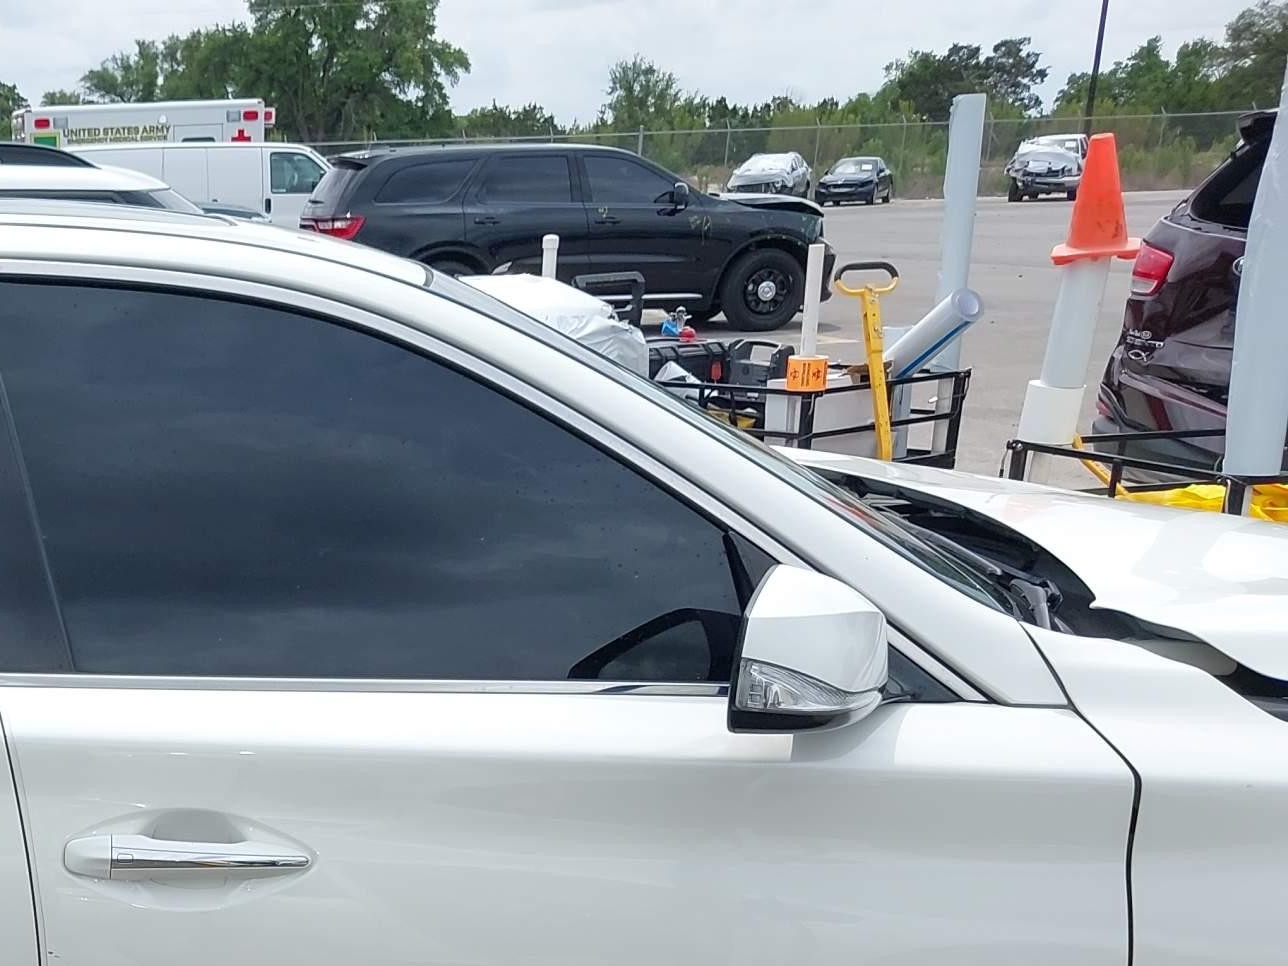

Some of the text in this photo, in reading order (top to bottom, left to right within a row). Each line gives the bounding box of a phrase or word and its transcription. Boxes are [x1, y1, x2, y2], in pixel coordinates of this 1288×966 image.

[63, 125, 171, 137] UNITED STATES ARMY
